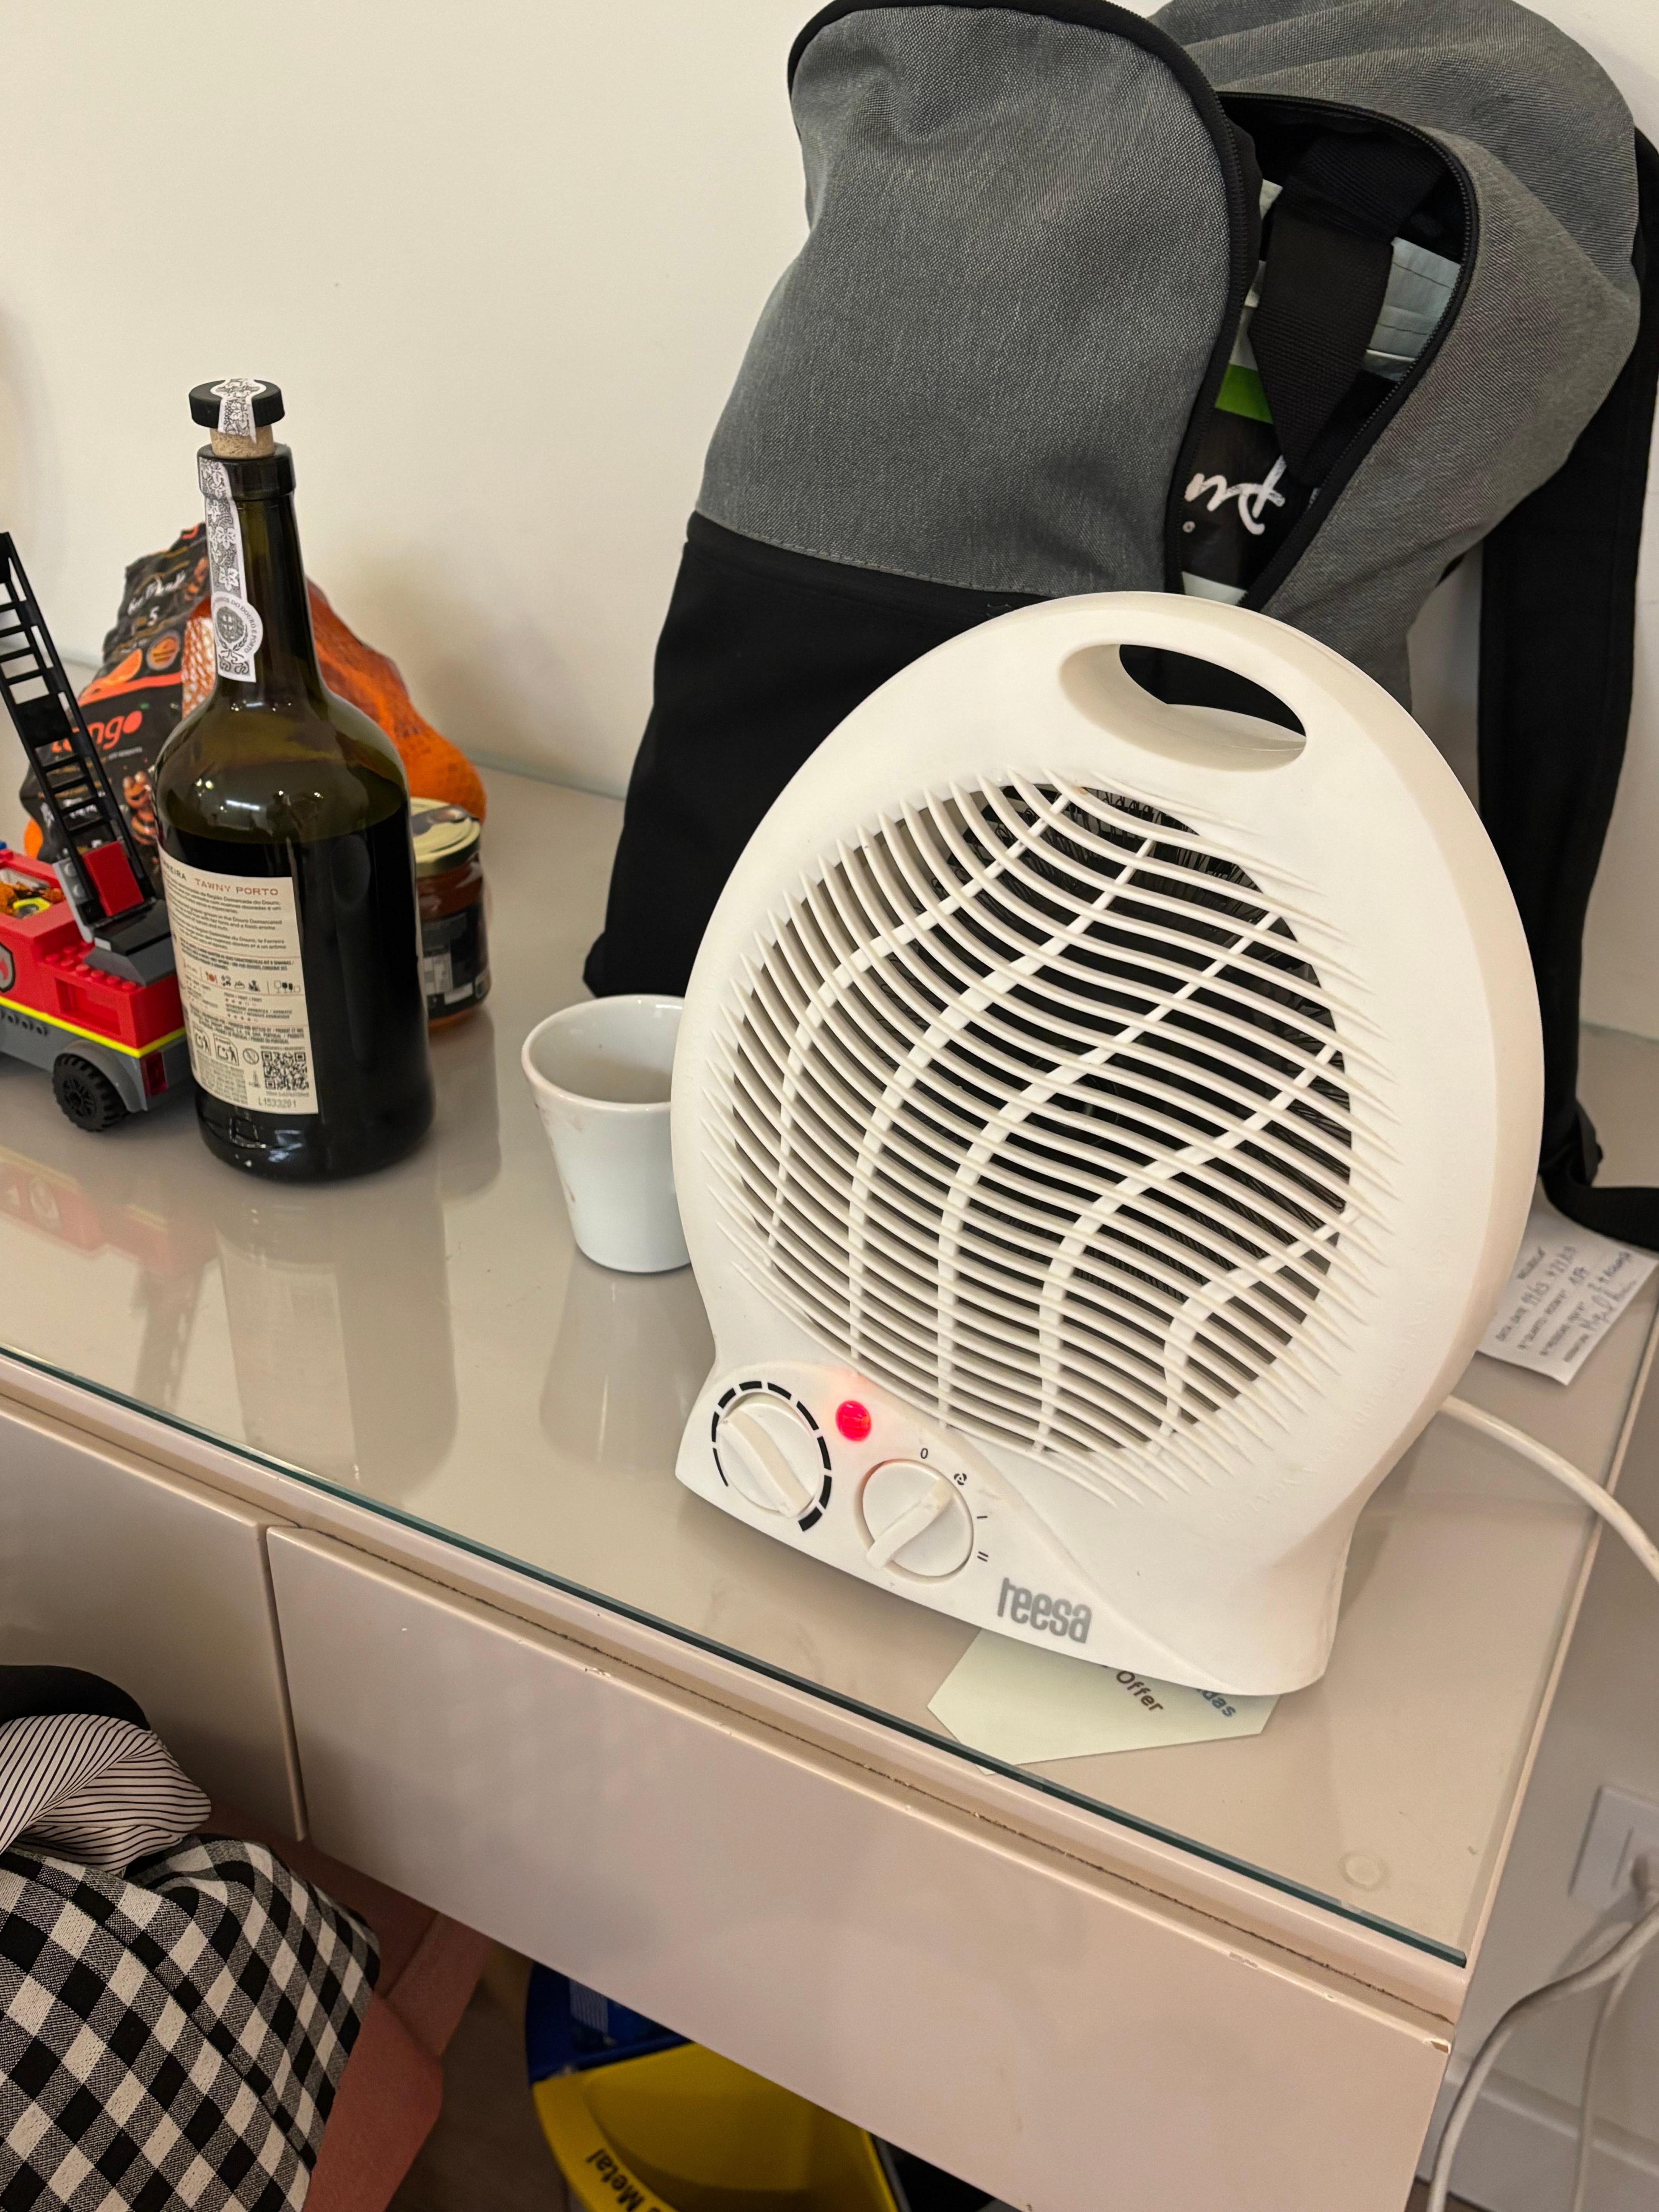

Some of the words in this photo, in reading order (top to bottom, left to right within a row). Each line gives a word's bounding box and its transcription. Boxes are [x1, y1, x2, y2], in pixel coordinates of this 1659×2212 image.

[194, 878, 230, 892] TAWNY
[236, 886, 278, 896] PORTO
[920, 1448, 929, 1459] 0
[997, 1577, 1092, 1644] reesa
[1116, 1670, 1163, 1711] Offer
[586, 2148, 645, 2212] Metal
